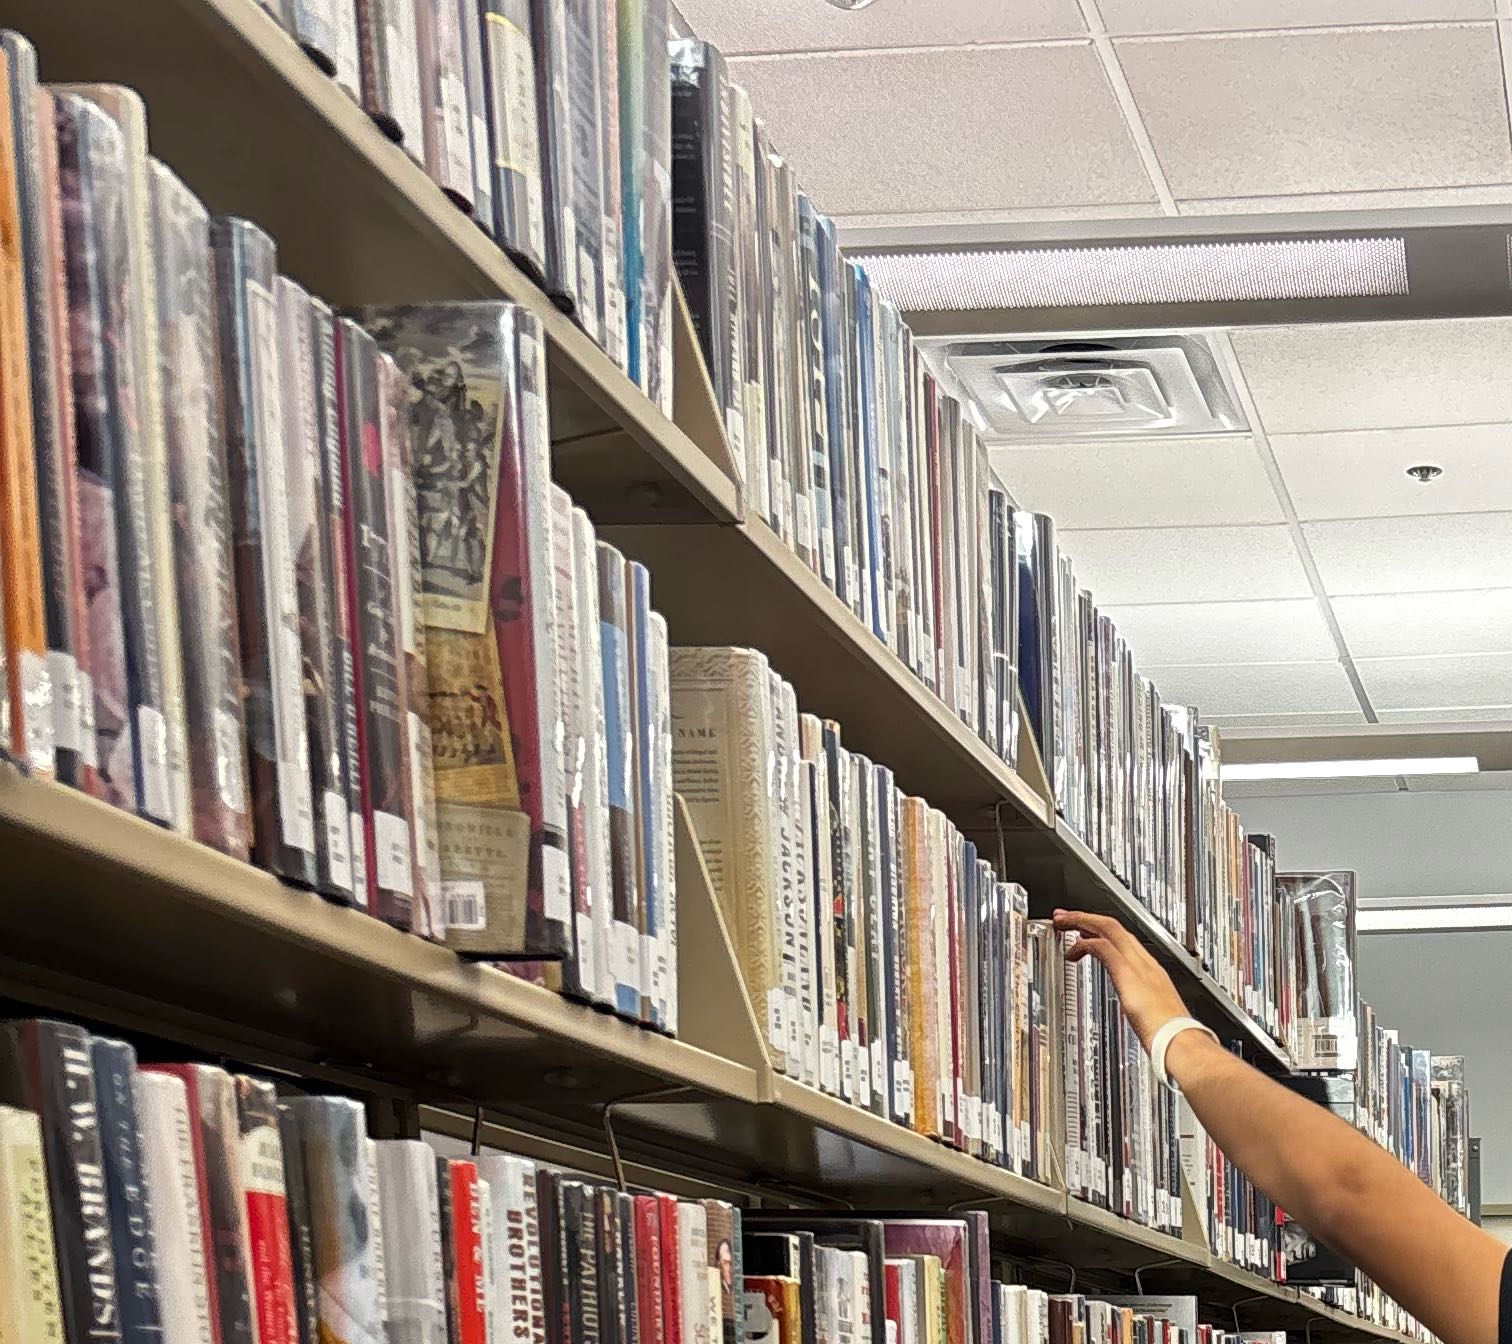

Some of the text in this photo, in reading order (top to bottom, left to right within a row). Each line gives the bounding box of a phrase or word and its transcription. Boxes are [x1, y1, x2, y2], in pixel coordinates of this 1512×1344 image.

[63, 1048, 115, 1325] H. W. BRANDS
[507, 1209, 531, 1339] BROTHERS
